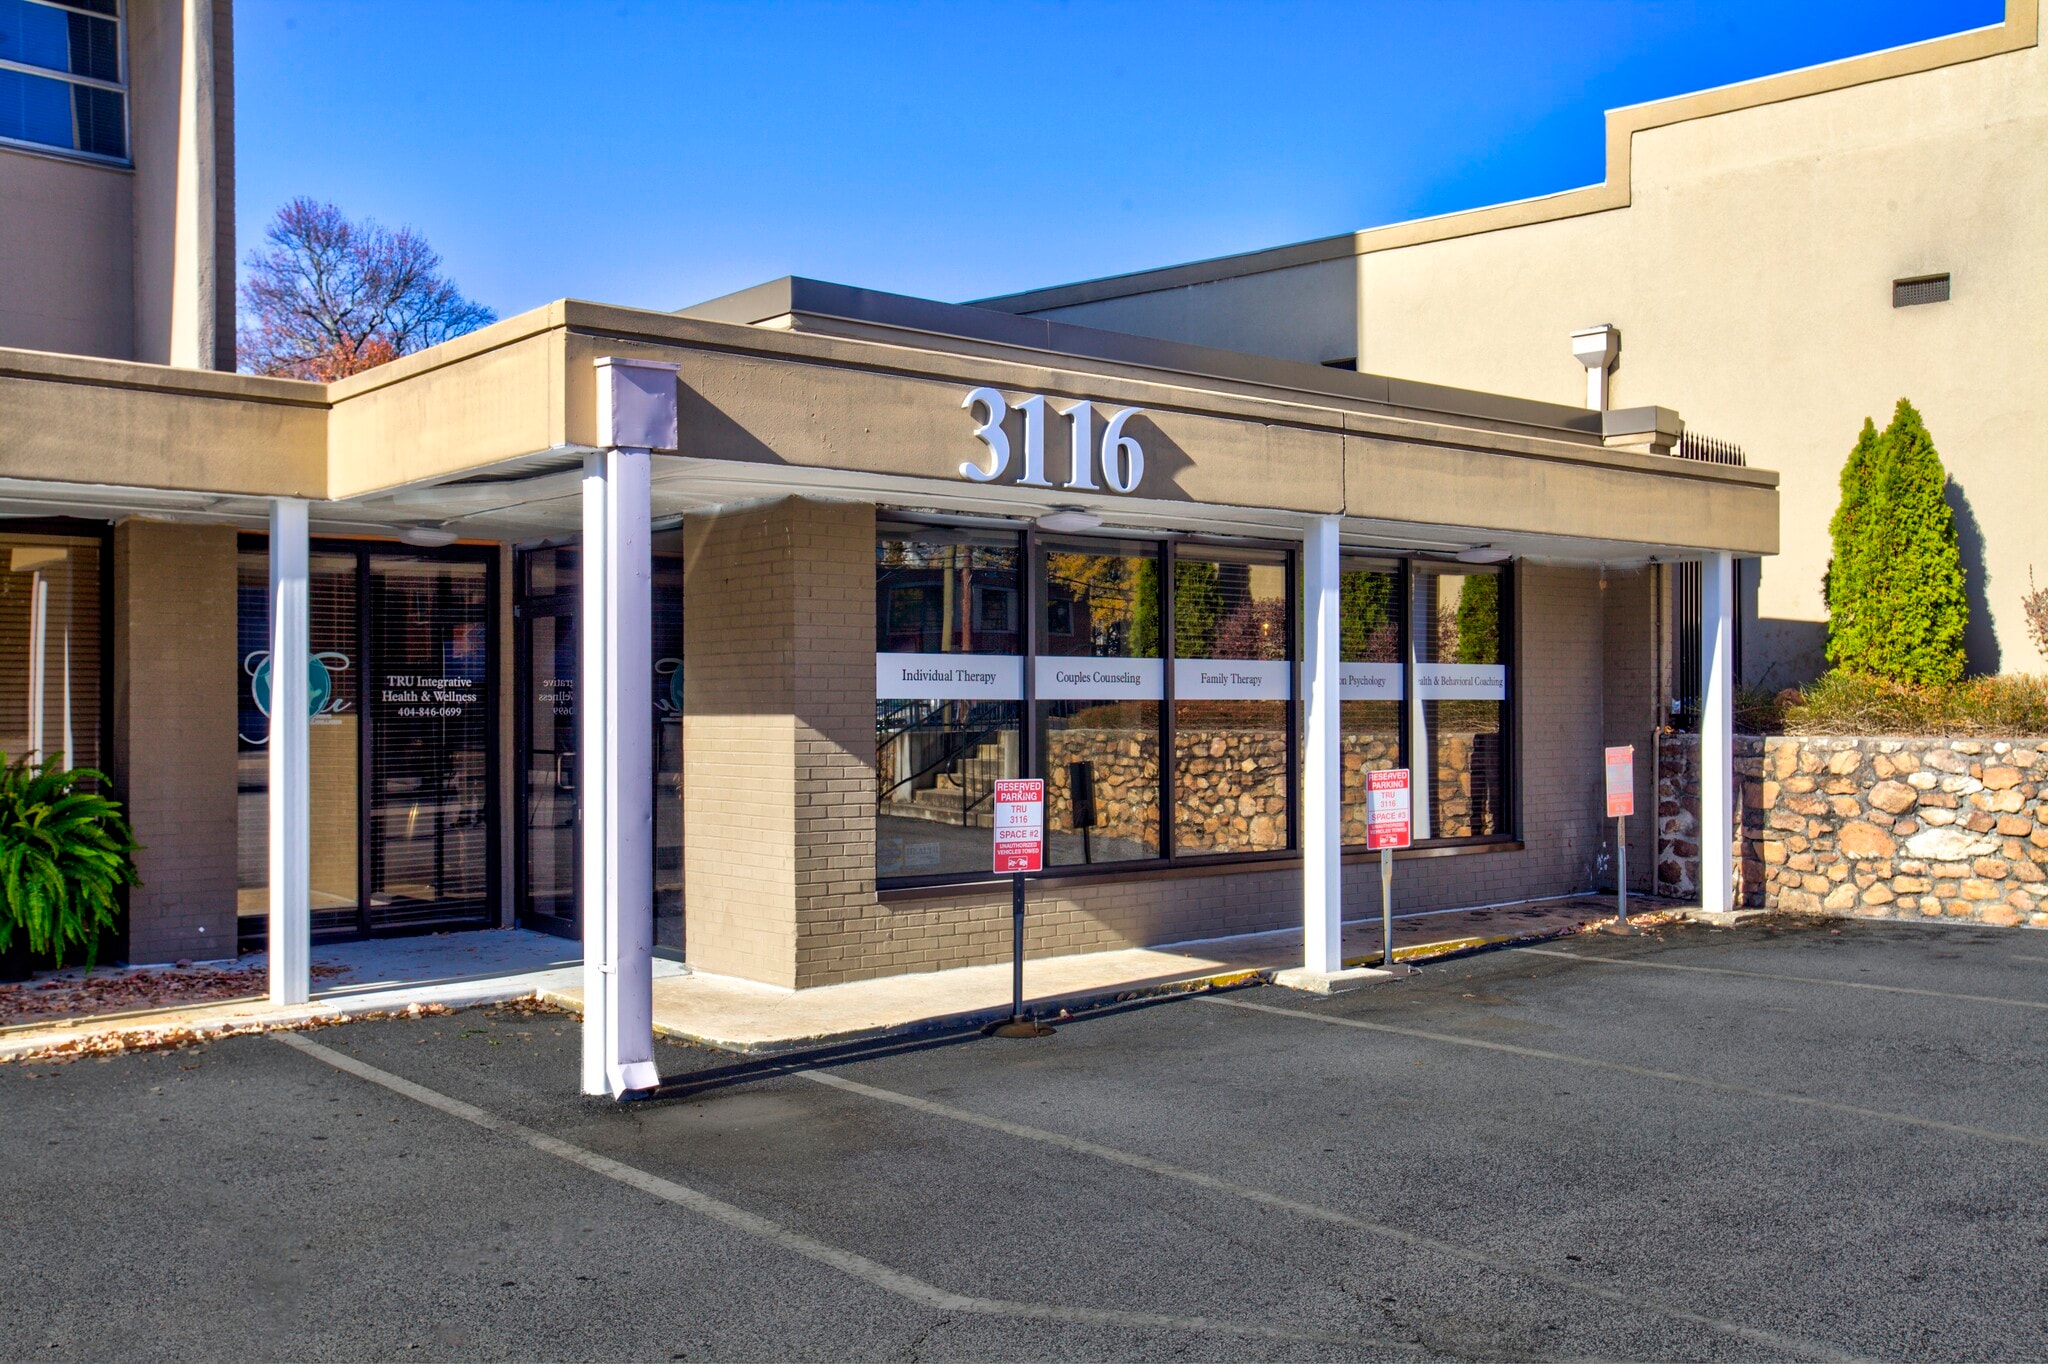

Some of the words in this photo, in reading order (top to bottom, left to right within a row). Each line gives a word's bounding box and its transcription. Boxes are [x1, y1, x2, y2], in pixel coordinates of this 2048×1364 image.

[959, 387, 1145, 494] 3116
[387, 675, 415, 687] TRU
[416, 676, 472, 689] Integrative
[902, 669, 953, 682] Individual
[955, 669, 997, 685] Therapy
[1056, 671, 1091, 685] Couples
[1092, 671, 1141, 685] Counseling
[1200, 673, 1229, 686] Family
[1231, 673, 1263, 687] Therapy
[1349, 675, 1386, 688] Psychology
[1433, 675, 1439, 686] &
[1441, 675, 1473, 686] Behavioral
[1474, 675, 1503, 688] Coaching
[381, 690, 418, 702] Health
[420, 690, 431, 702] &
[433, 690, 477, 702] Wellness
[397, 707, 462, 717] 404-846-0699
[1368, 772, 1407, 781] RESERVED
[997, 782, 1041, 791] RESERVED
[1372, 781, 1404, 790] PARKING
[1001, 792, 1037, 801] PARKING
[1011, 805, 1027, 813] TRU
[1380, 800, 1397, 808] 3116
[1010, 815, 1028, 823] 3116
[1371, 812, 1396, 821] SPACE
[1397, 811, 1406, 819] #3
[999, 830, 1027, 839] SPACE
[1029, 829, 1039, 838] #2
